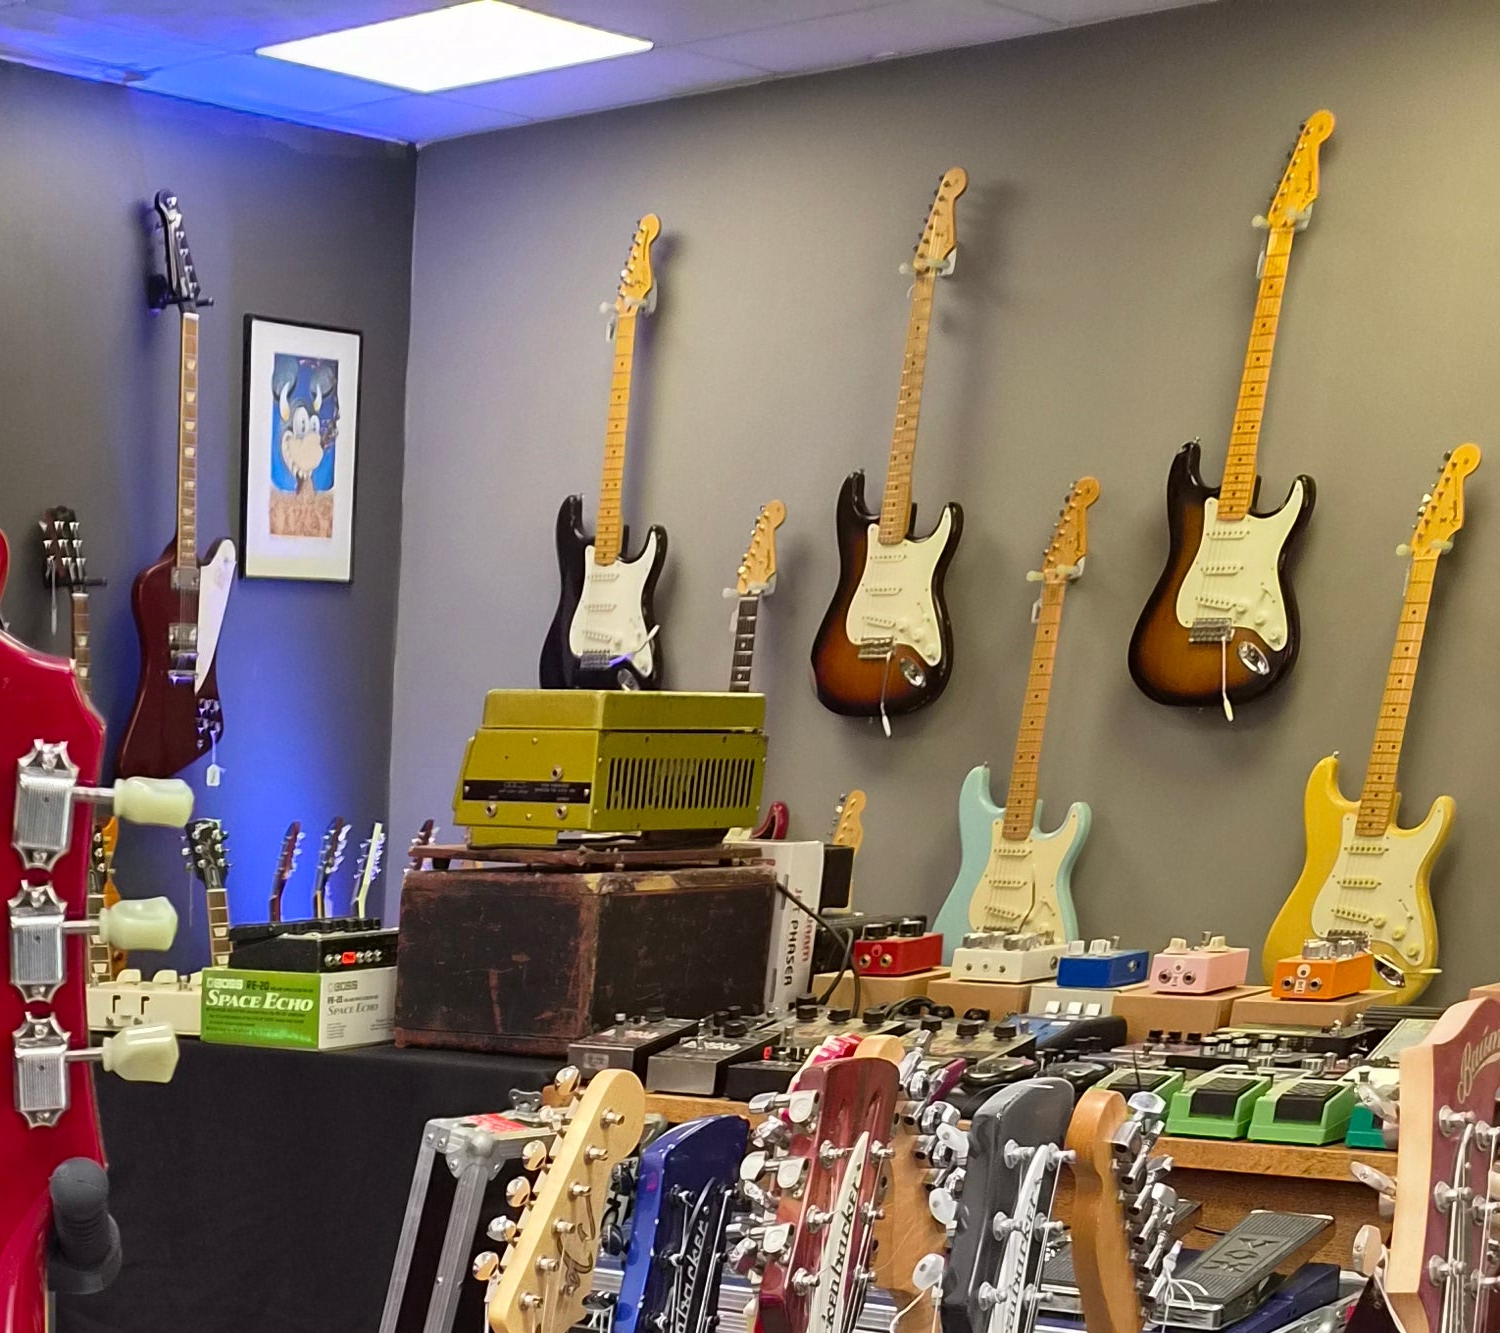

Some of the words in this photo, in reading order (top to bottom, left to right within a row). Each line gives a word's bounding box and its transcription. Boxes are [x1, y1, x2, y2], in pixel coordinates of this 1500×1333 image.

[783, 920, 799, 986] PHASER
[334, 980, 358, 991] BOSS
[206, 990, 261, 1009] SPACE
[263, 992, 314, 1012] ECHO
[327, 1004, 354, 1016] SPACE
[355, 1002, 379, 1013] ECHO
